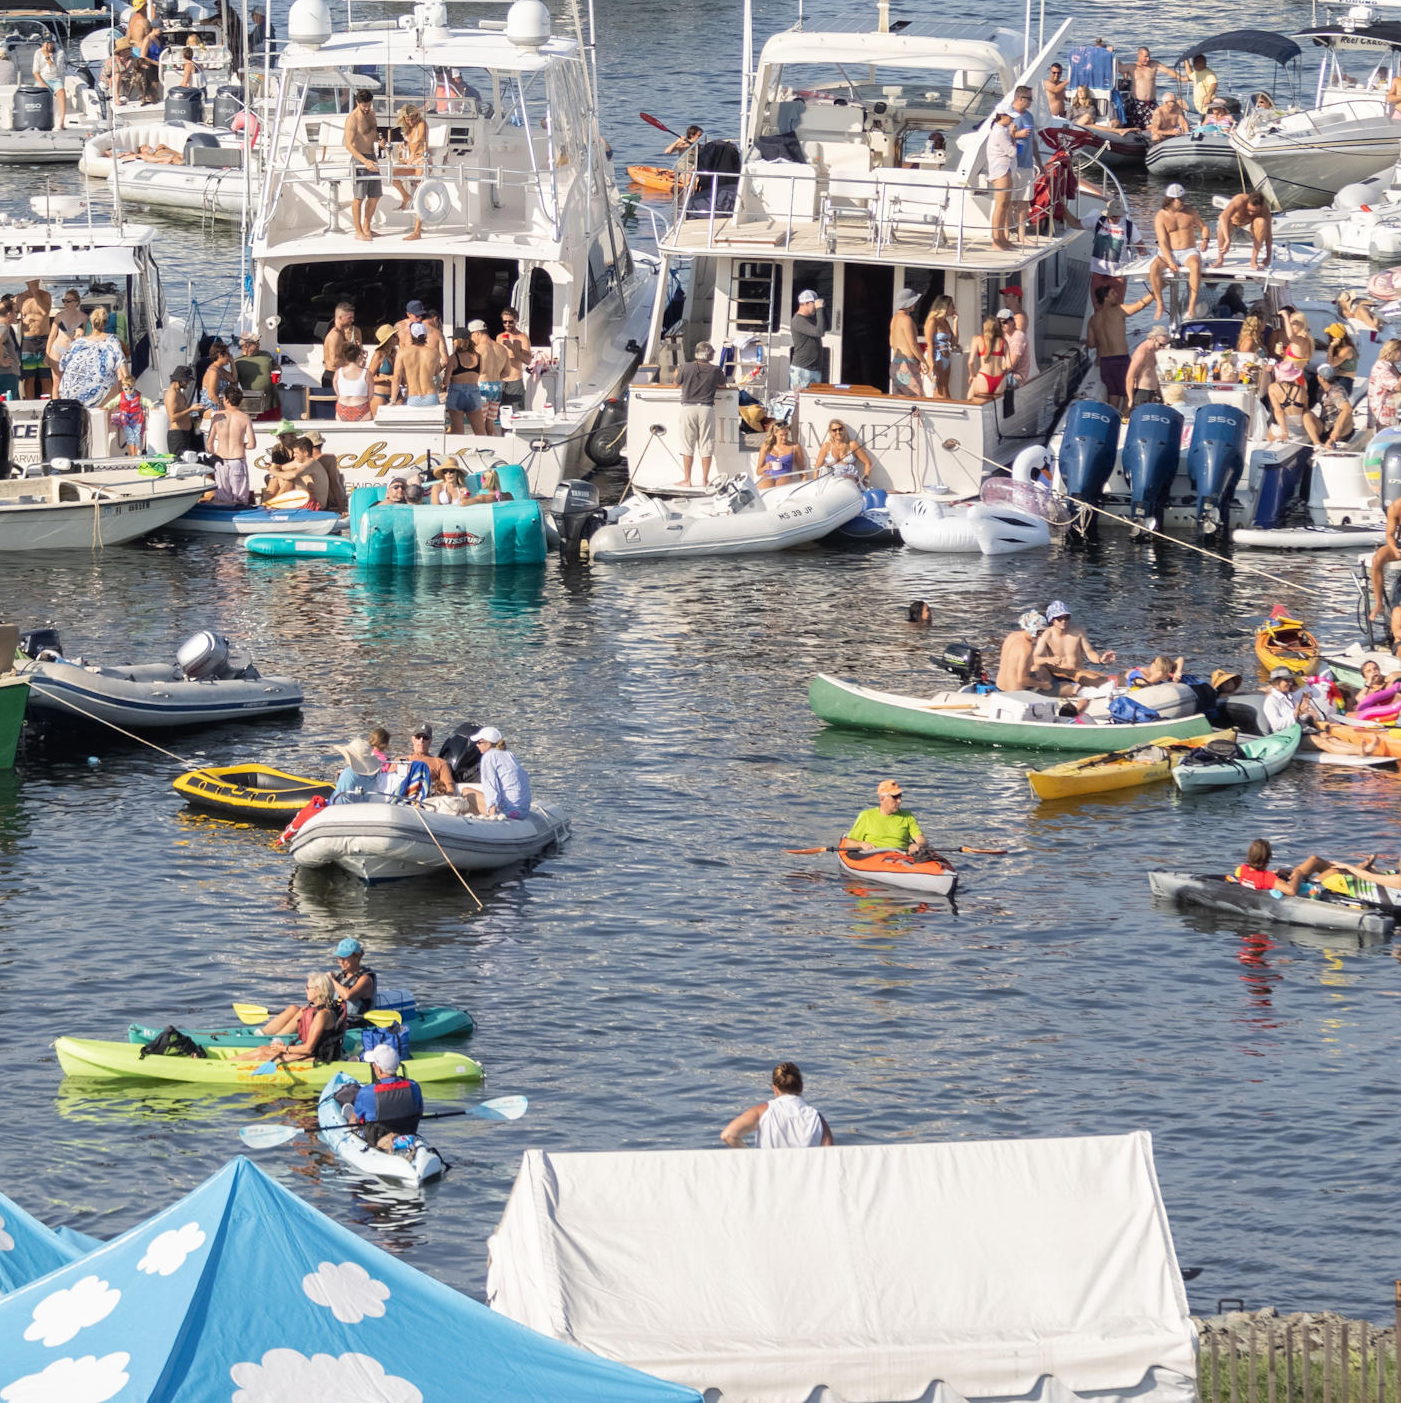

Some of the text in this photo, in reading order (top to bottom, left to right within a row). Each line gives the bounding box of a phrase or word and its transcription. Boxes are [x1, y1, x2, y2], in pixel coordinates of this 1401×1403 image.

[1081, 411, 1110, 424] 350
[1141, 414, 1170, 425] 350
[1207, 415, 1236, 426] 350
[13, 425, 39, 439] CE
[426, 533, 485, 547] SPORTSSTUFF
